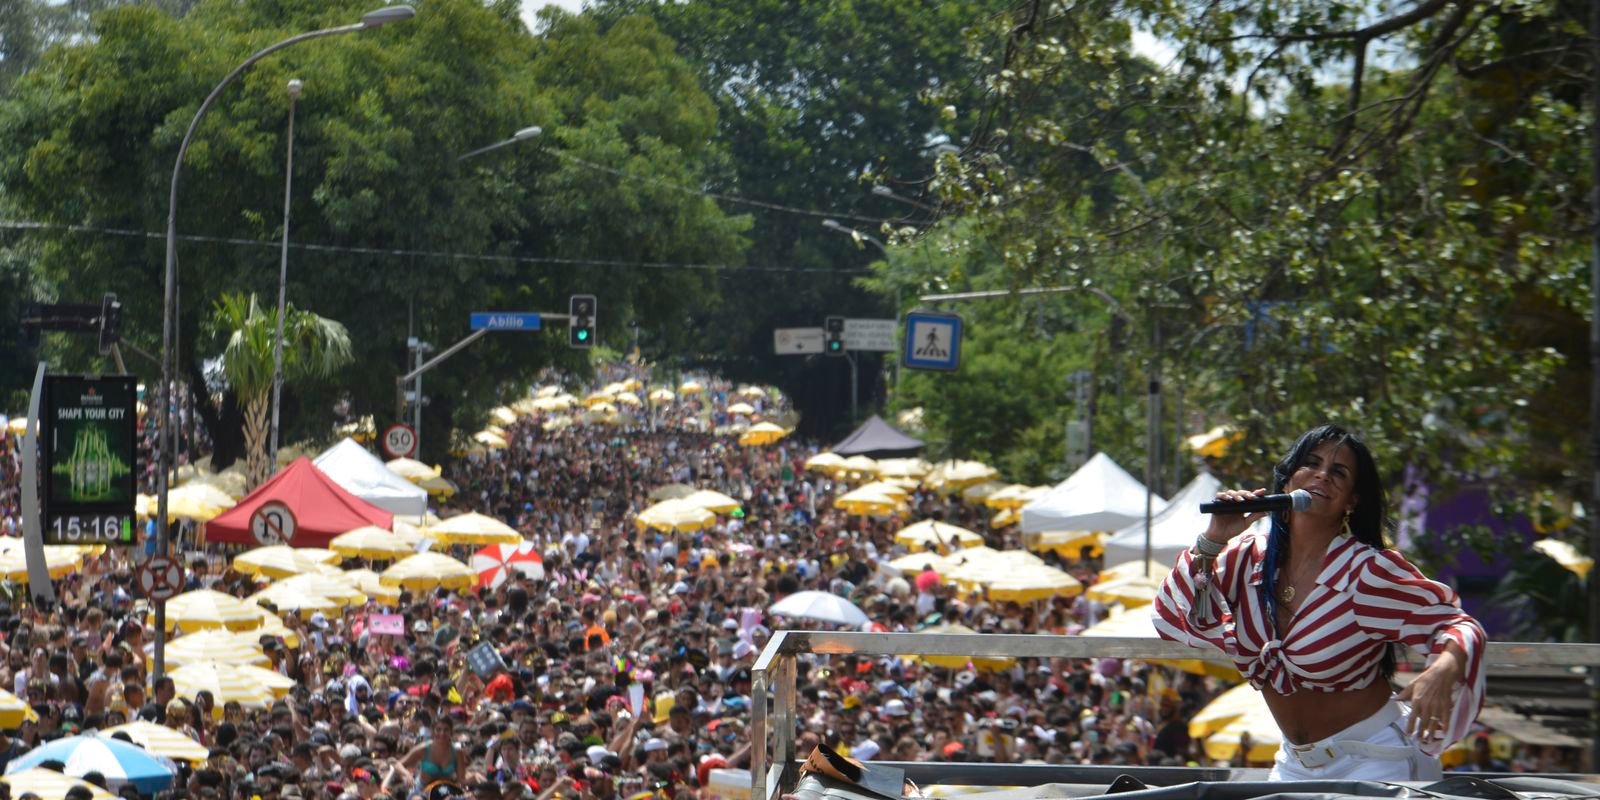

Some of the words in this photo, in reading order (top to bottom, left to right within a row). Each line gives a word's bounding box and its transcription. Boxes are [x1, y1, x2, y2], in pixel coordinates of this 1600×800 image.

[58, 408, 82, 420] SHAPE
[85, 408, 106, 420] YOUR
[108, 408, 126, 420] CITY
[389, 431, 411, 446] 50
[53, 515, 119, 541] 15:16
